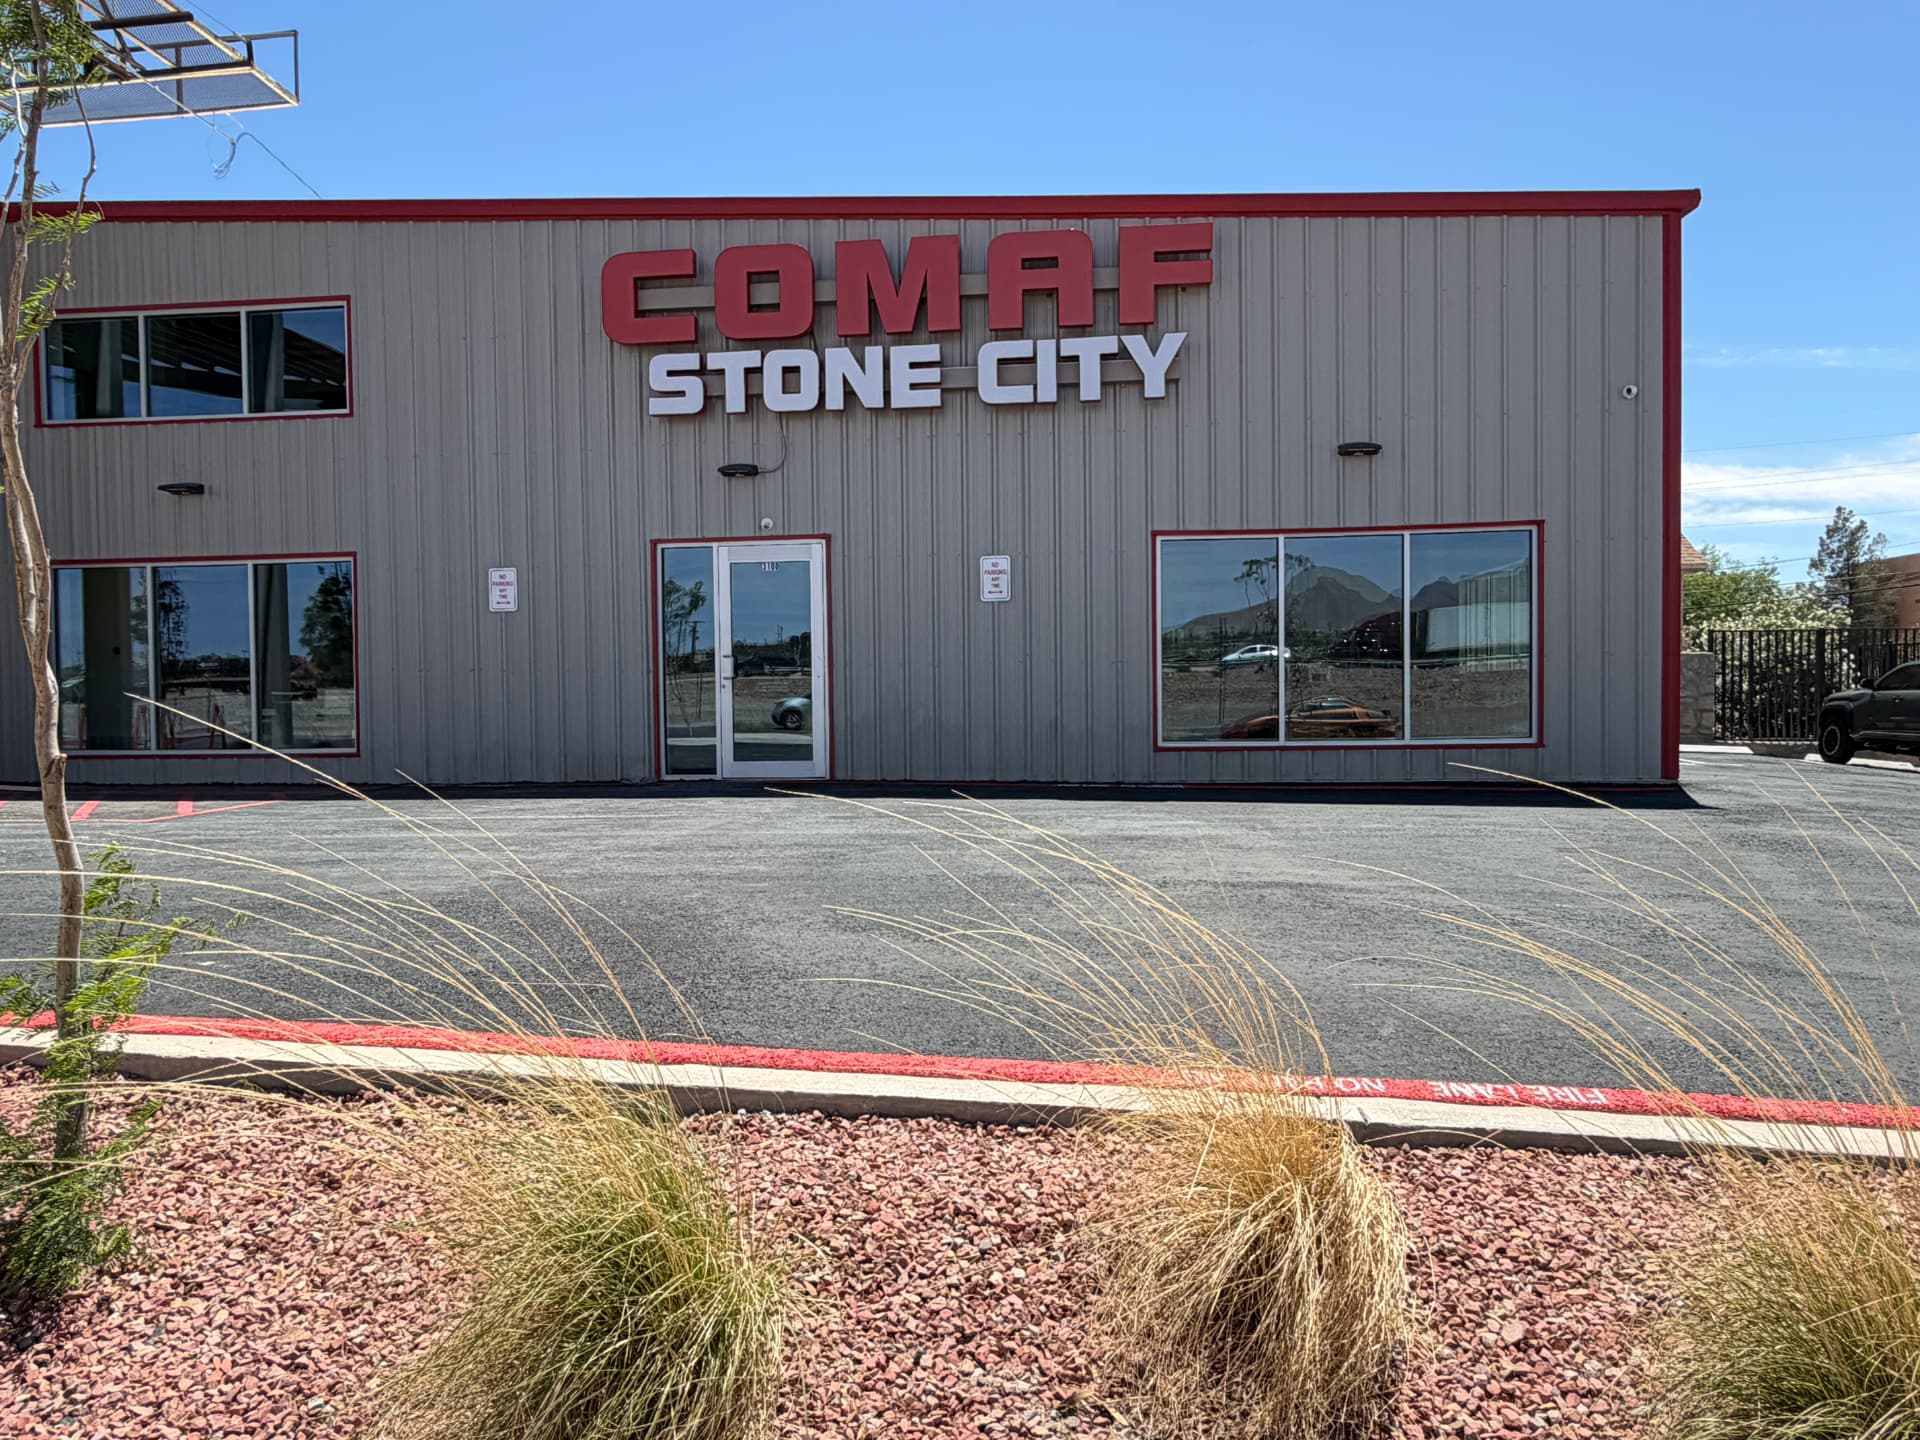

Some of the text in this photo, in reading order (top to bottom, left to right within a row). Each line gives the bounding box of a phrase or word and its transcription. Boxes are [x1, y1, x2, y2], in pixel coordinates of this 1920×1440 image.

[601, 222, 1214, 344] COMAF
[648, 331, 1189, 417] STONE CITY
[1334, 1077, 1386, 1093] NO
[1428, 1080, 1519, 1099] LANE
[1533, 1084, 1608, 1104] FIRE
